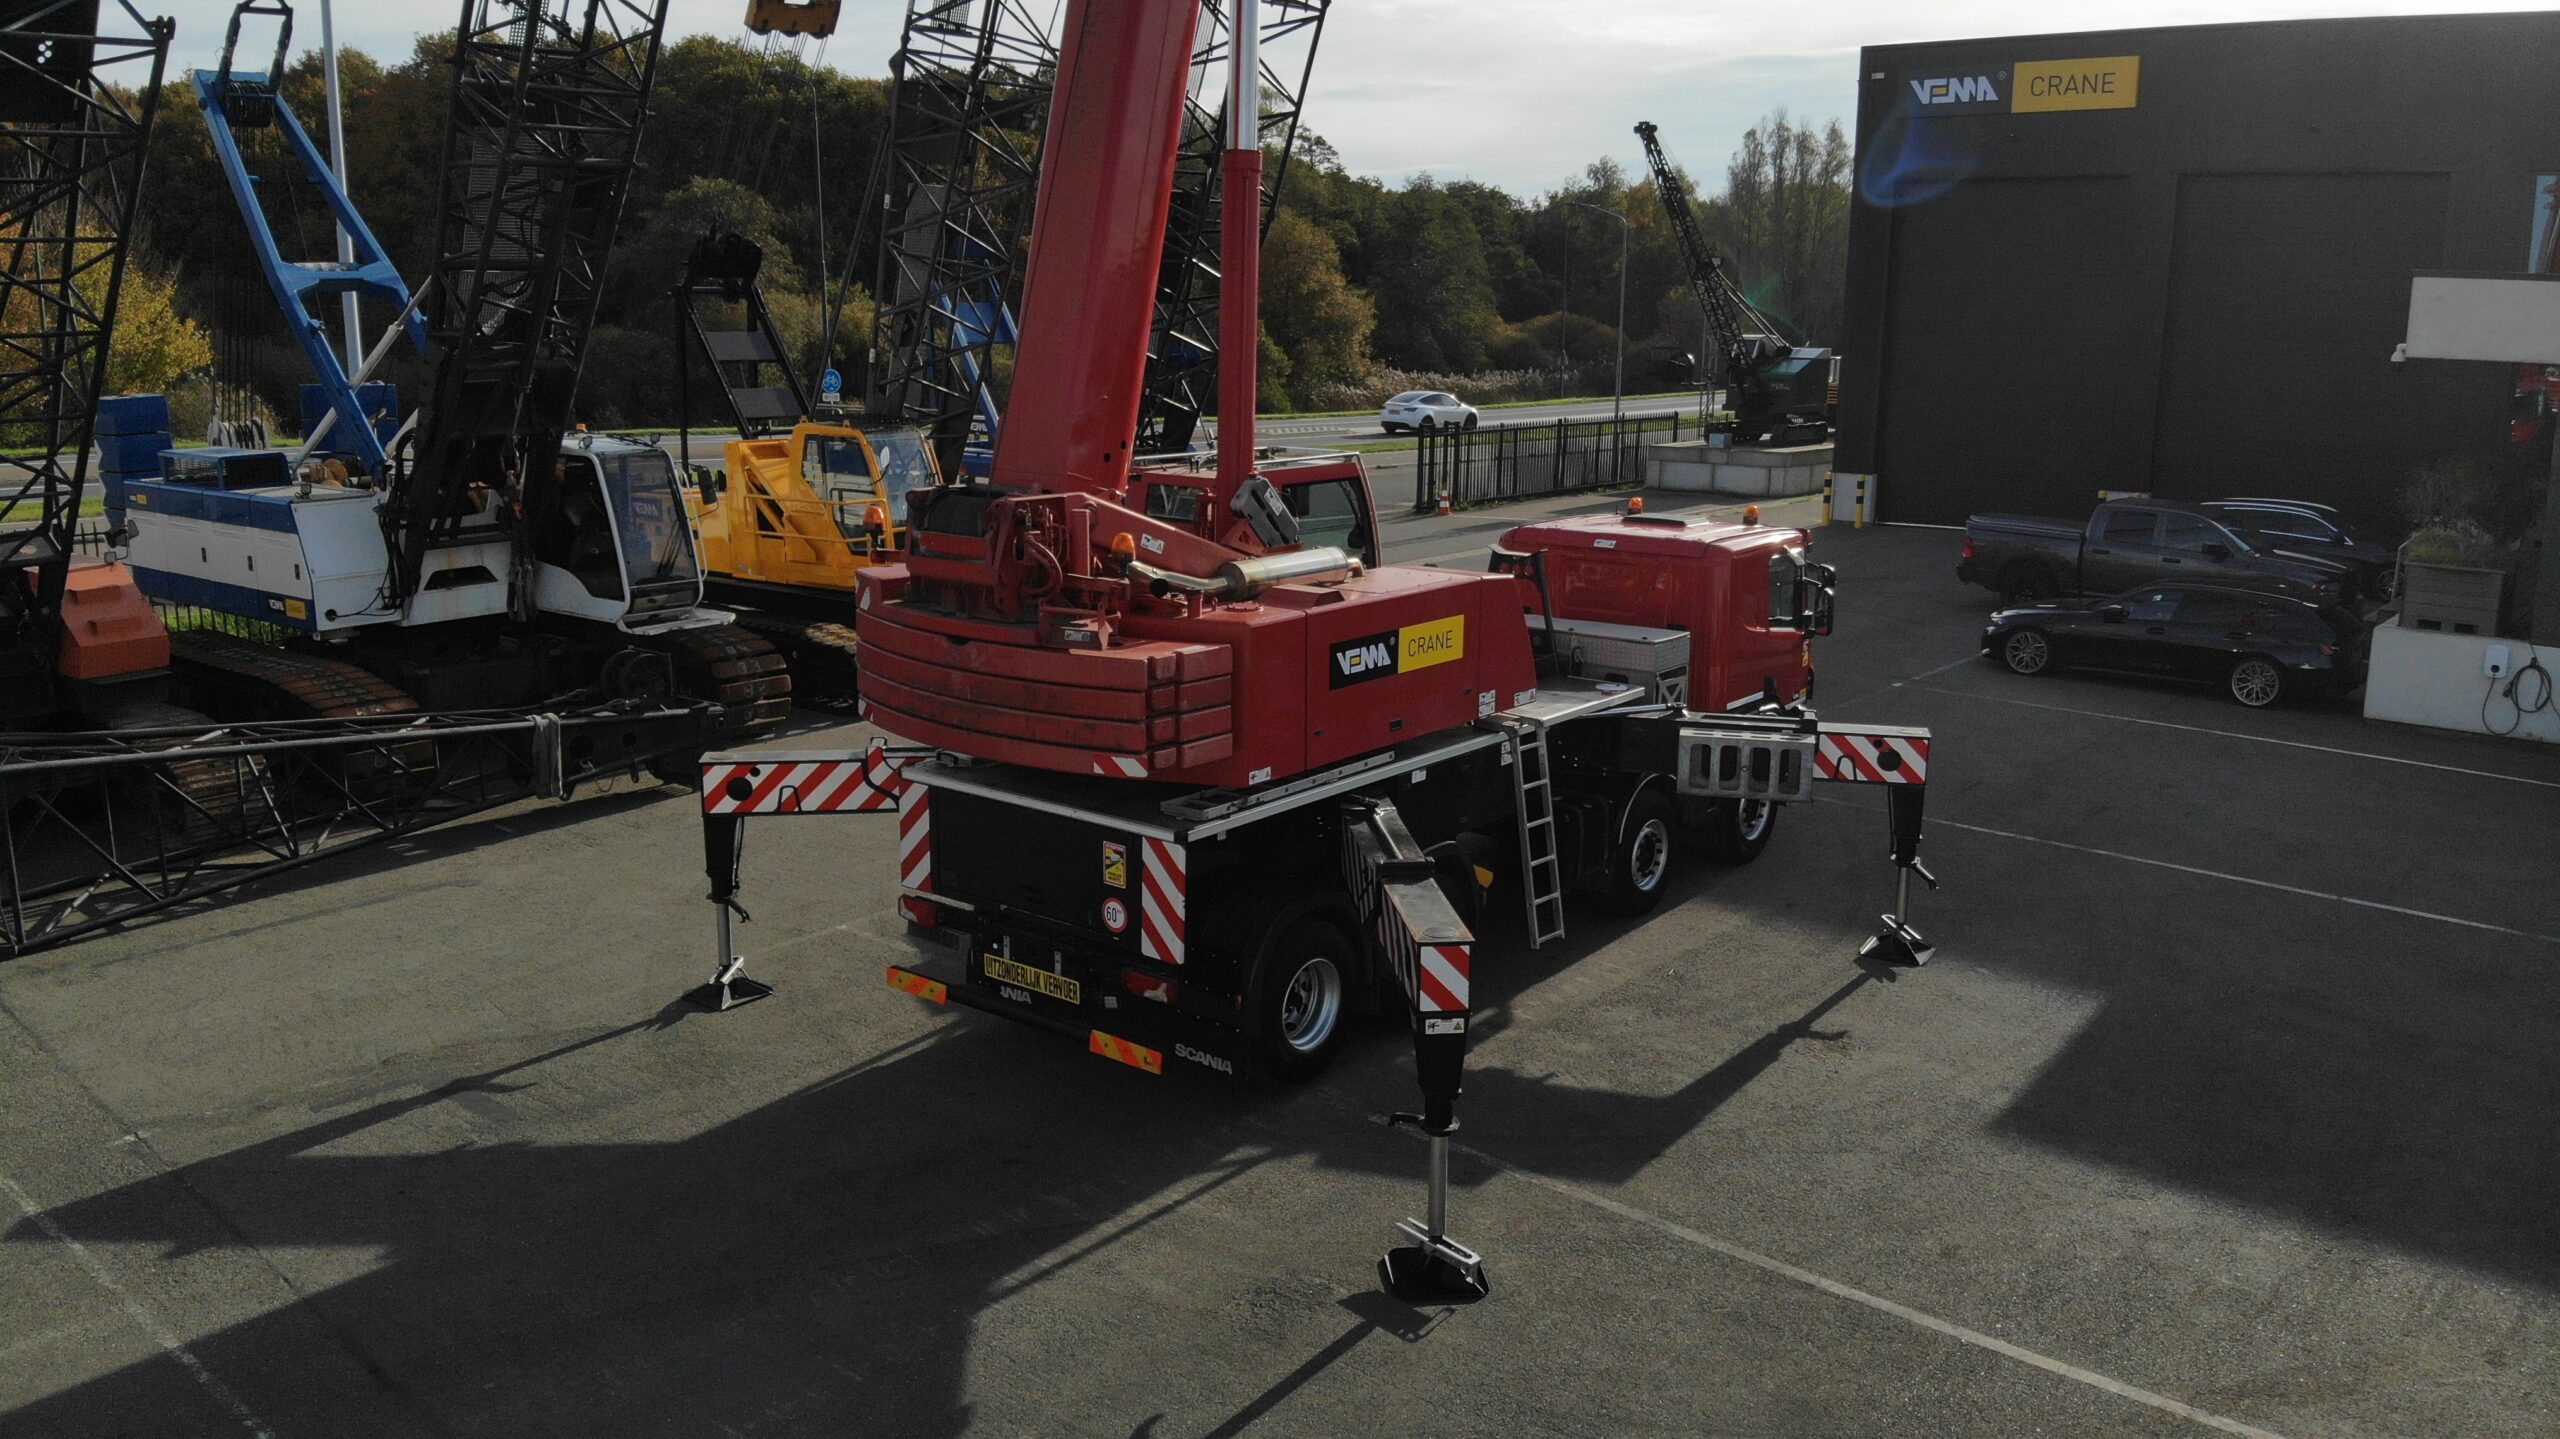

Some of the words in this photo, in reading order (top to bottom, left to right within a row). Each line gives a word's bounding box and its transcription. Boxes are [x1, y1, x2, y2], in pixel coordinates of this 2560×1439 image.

[1910, 75, 1999, 104] VEMA
[2030, 72, 2116, 97] CRANE
[1336, 642, 1391, 675] VEMA
[1408, 630, 1453, 657] CRANE
[1107, 905, 1117, 923] 60
[1175, 1043, 1232, 1075] SCANIA
